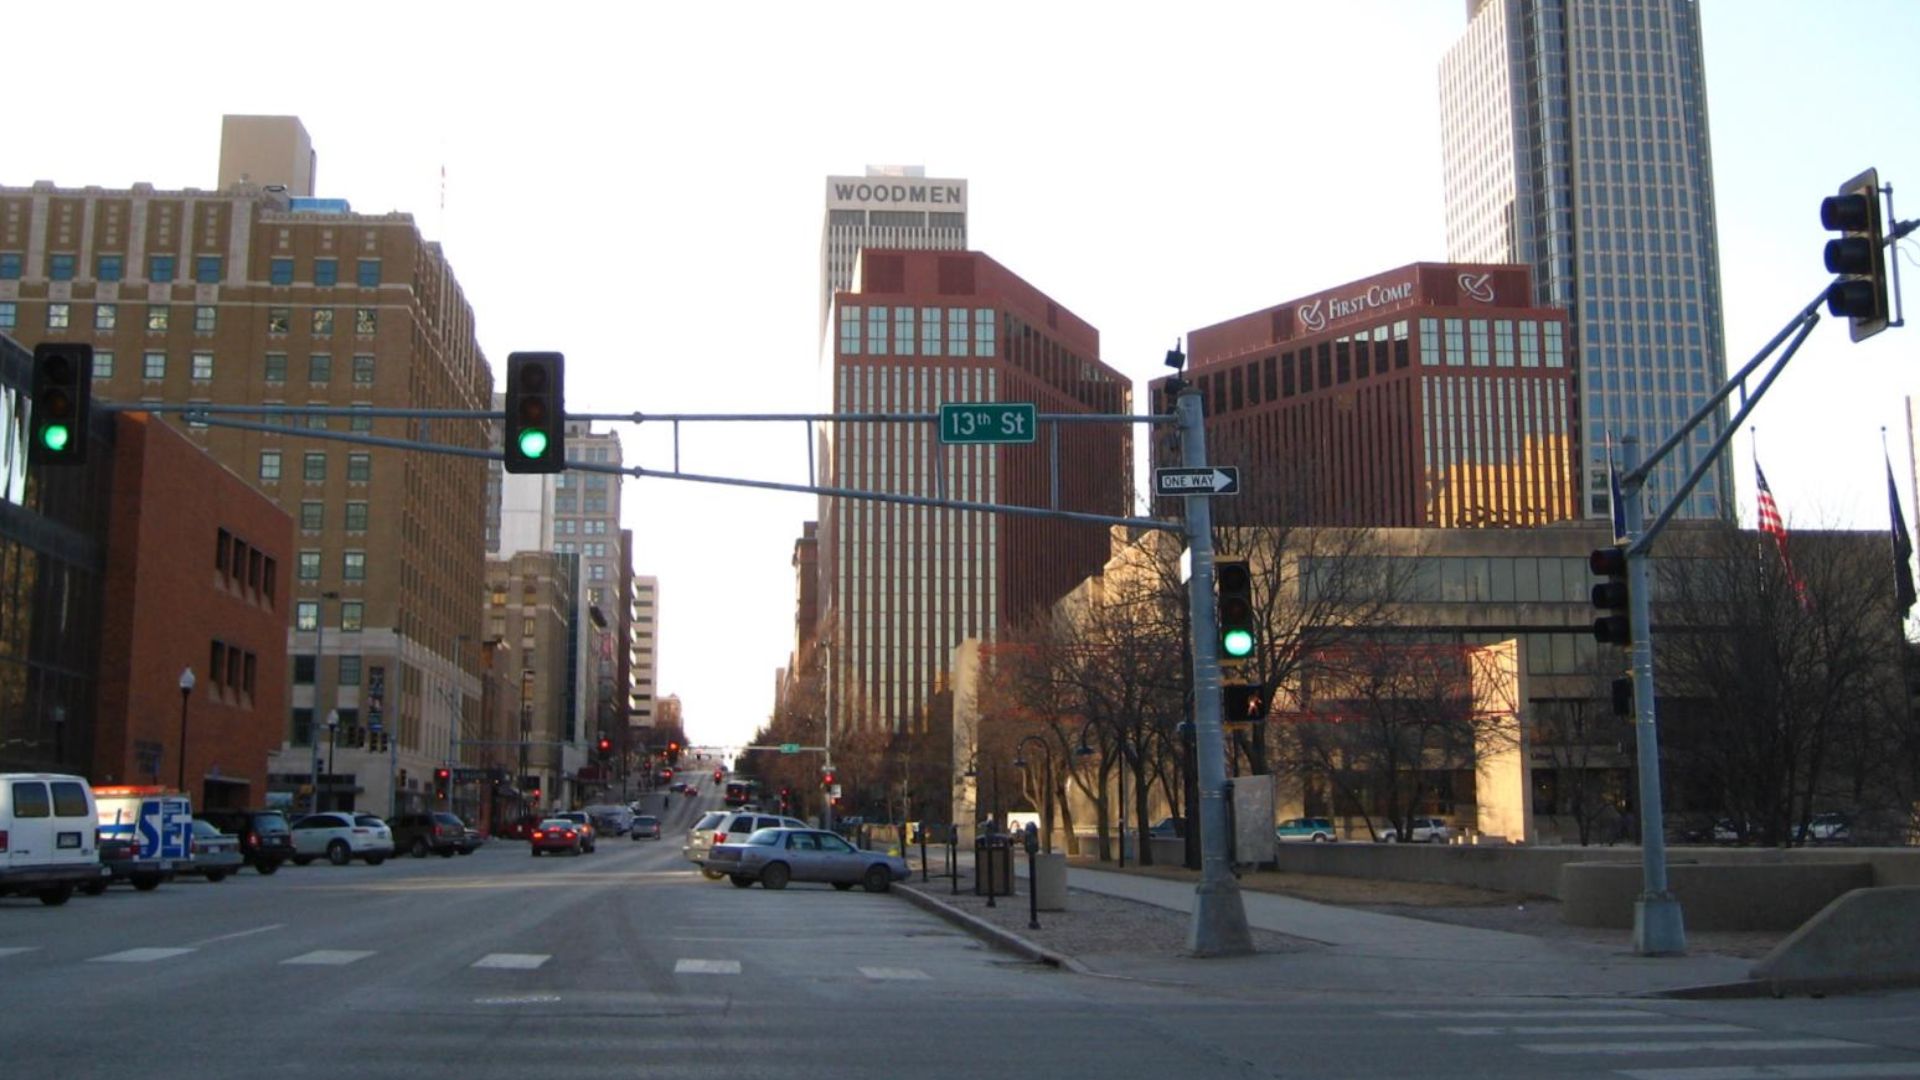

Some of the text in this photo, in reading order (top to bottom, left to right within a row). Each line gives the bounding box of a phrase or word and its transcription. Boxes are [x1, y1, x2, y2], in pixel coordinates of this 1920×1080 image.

[835, 183, 961, 204] WOODMEN
[951, 411, 1025, 435] 13th St
[1163, 474, 1215, 488] ONE WAY
